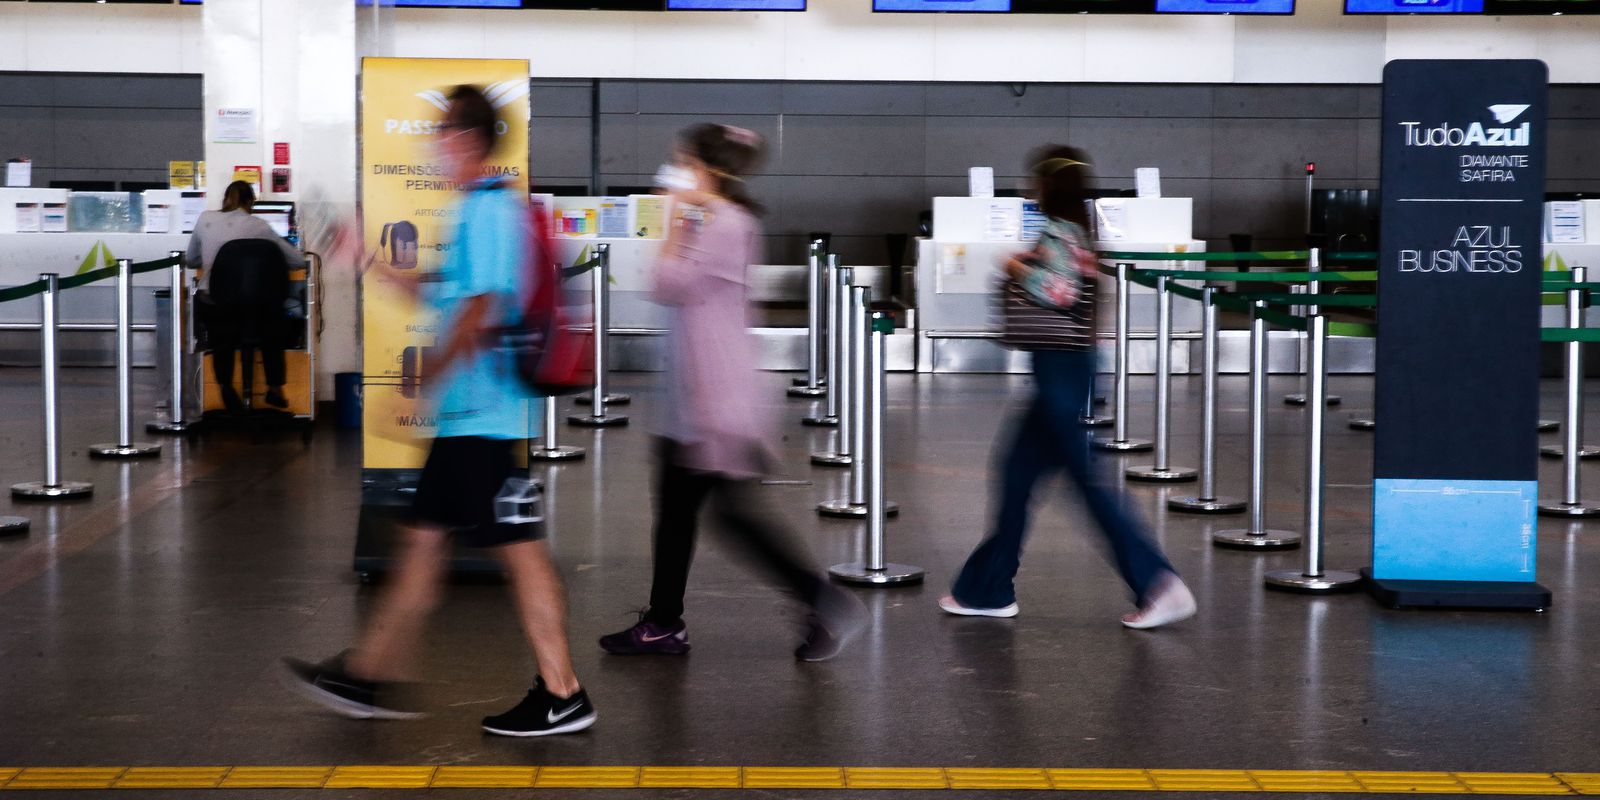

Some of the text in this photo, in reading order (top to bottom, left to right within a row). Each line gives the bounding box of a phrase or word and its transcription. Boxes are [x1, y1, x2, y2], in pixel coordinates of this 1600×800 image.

[1398, 122, 1530, 146] TudoAzul
[1459, 154, 1529, 168] DIAMANTE
[1459, 169, 1516, 182] SAFIRA
[1451, 225, 1523, 248] AZUL
[1397, 249, 1523, 273] BUSINESS
